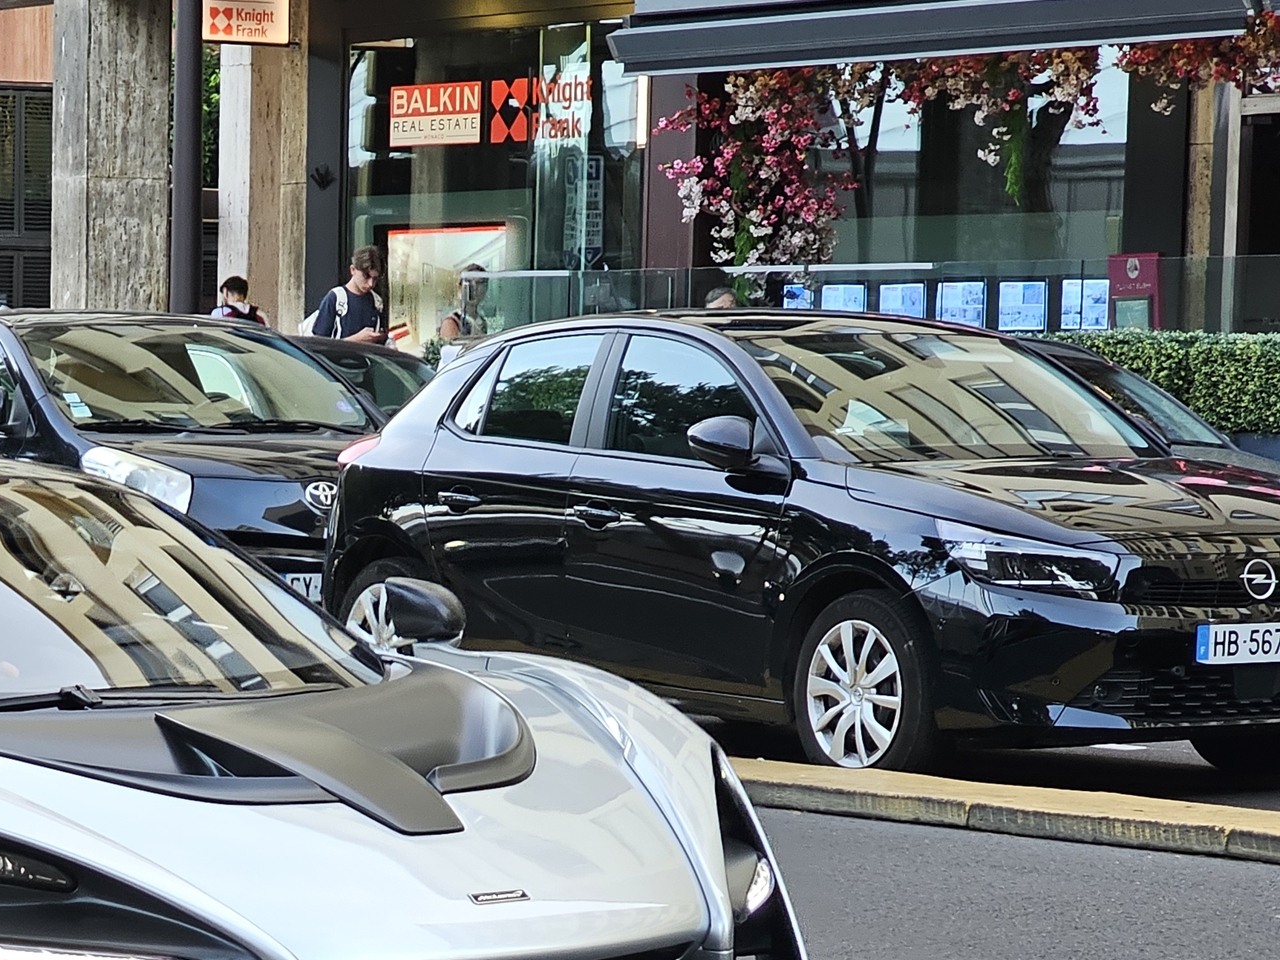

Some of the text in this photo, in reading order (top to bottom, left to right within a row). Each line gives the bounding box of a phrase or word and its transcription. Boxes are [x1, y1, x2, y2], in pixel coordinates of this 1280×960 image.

[236, 8, 274, 25] Knight
[236, 25, 268, 38] Frank
[393, 85, 479, 115] BALKIN
[532, 74, 593, 110] Knight
[393, 117, 477, 133] REAL ESTATE
[532, 111, 581, 140] Frank
